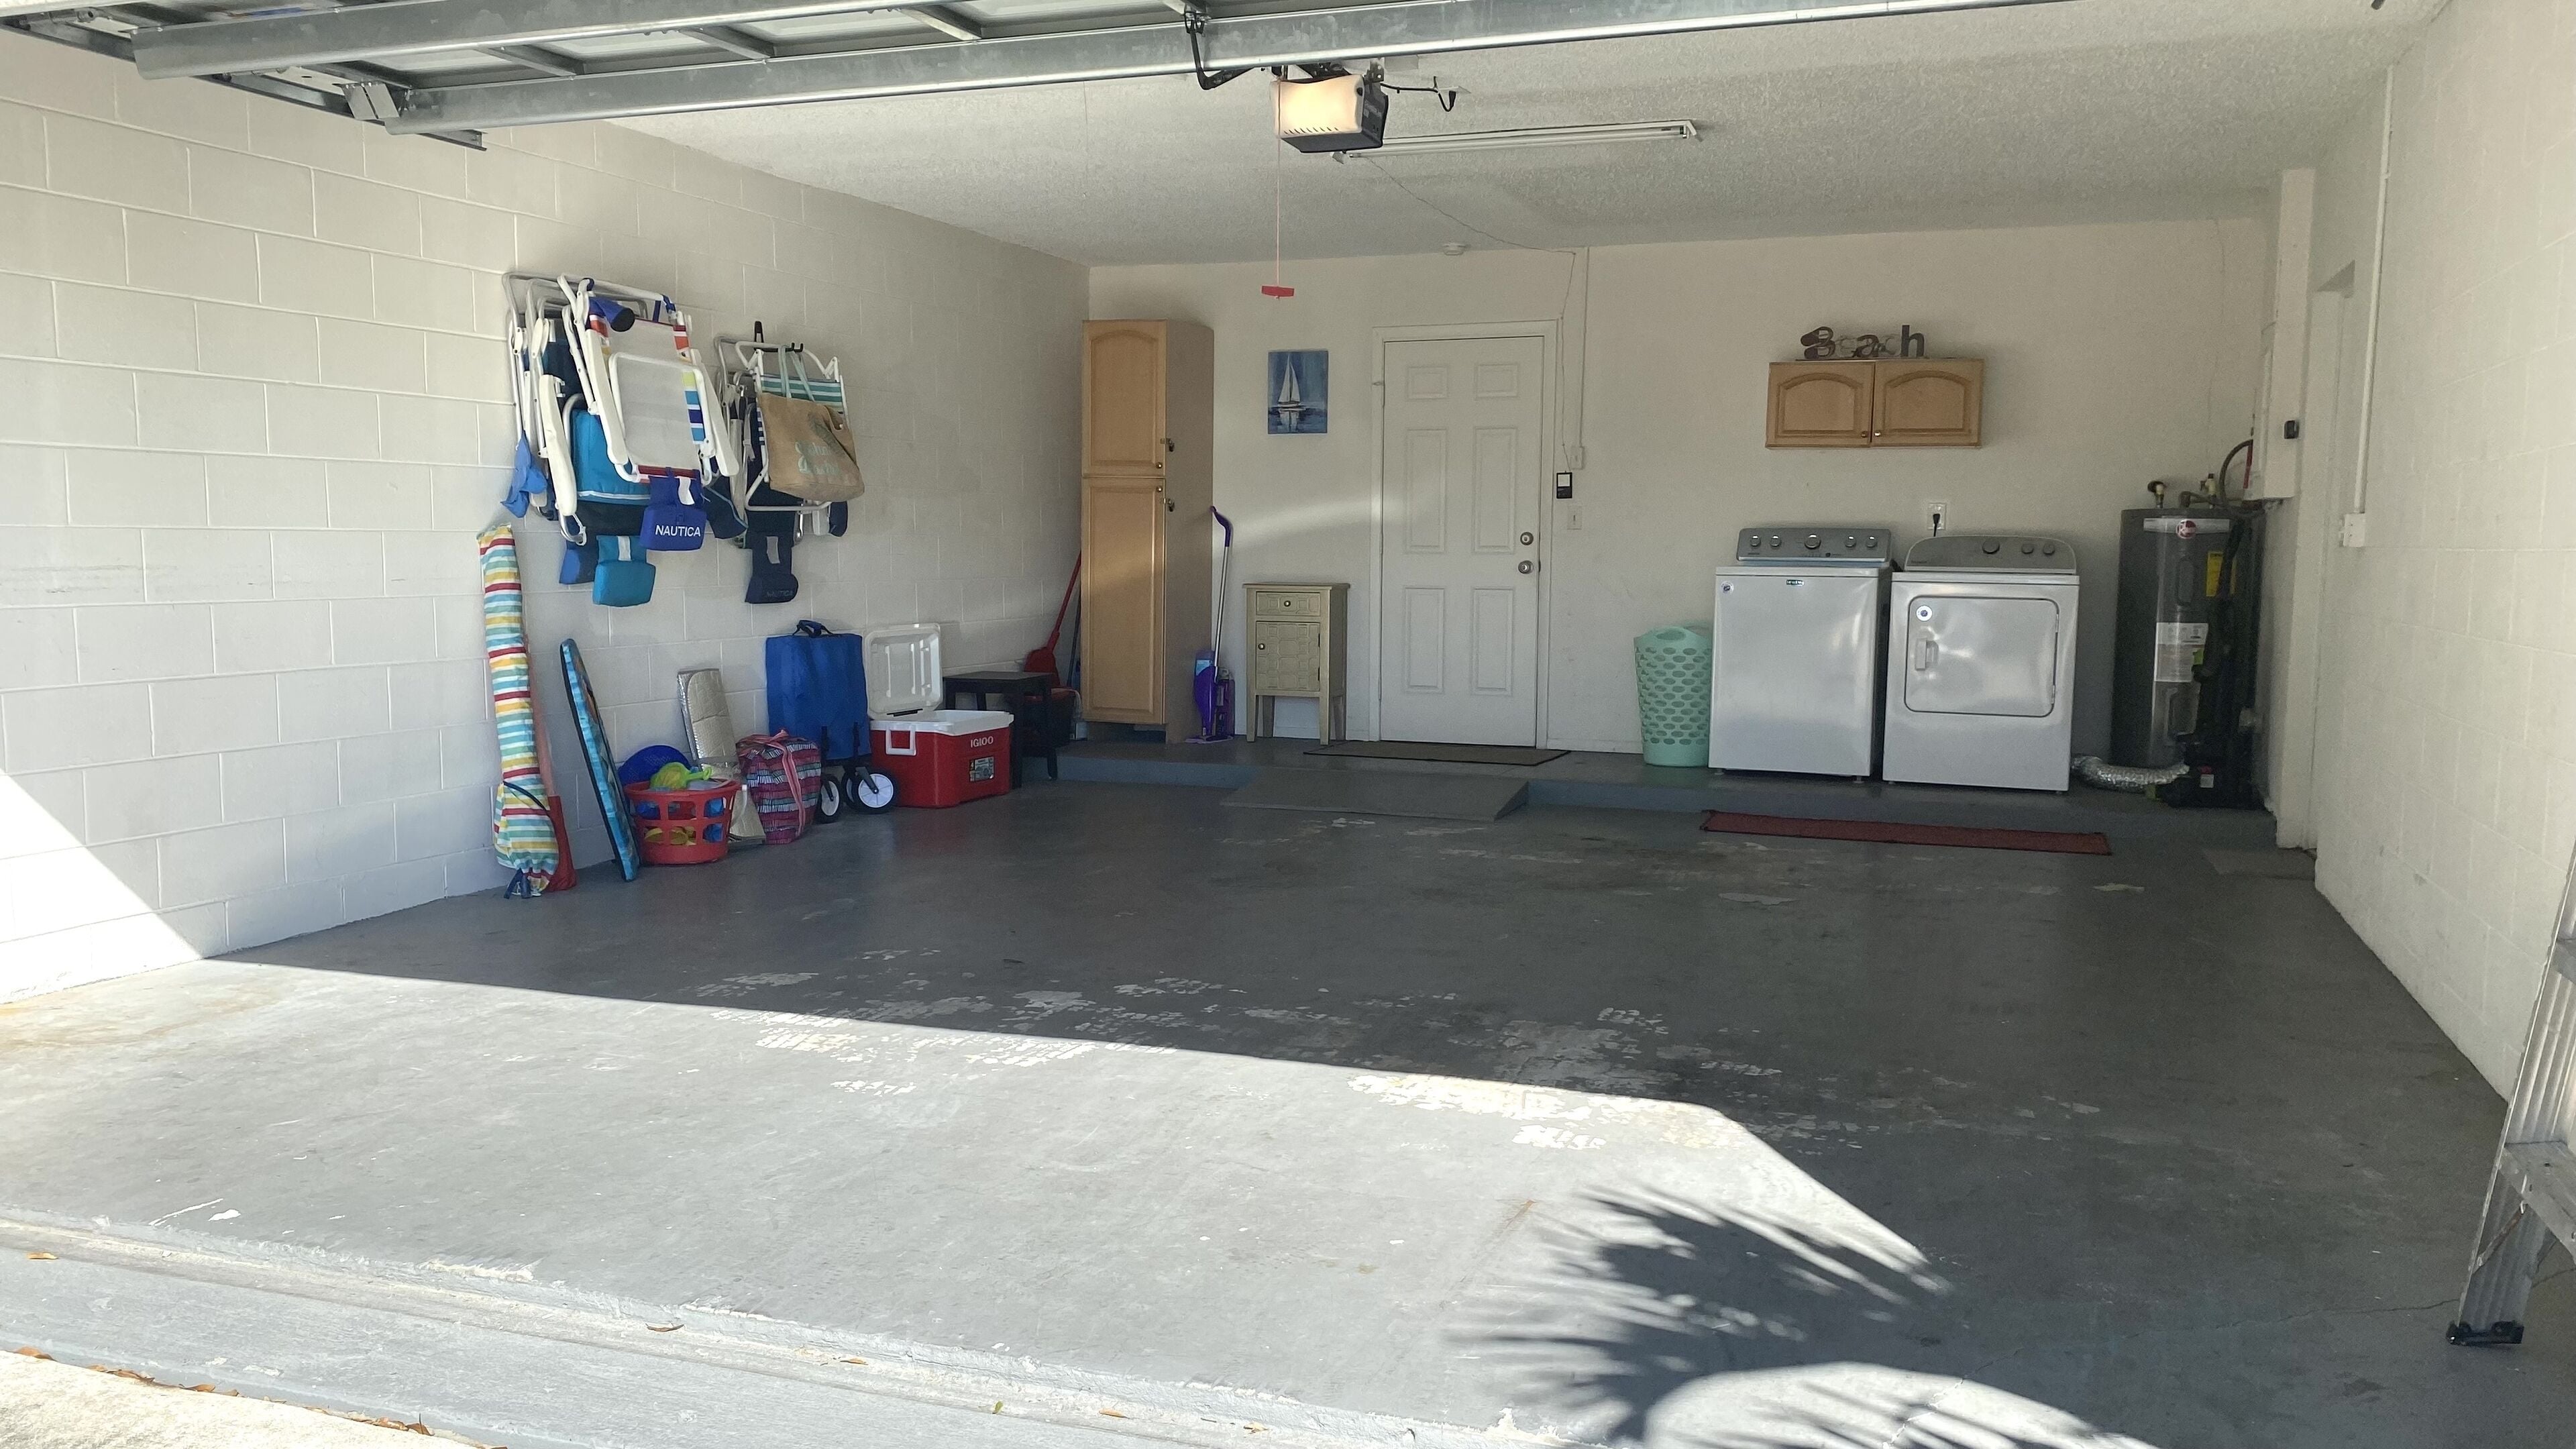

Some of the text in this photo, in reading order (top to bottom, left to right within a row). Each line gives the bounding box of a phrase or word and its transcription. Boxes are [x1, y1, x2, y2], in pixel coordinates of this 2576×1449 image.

[1801, 324, 1925, 359] Beach
[655, 525, 701, 537] NAUTICA
[970, 736, 994, 748] IGLOO
